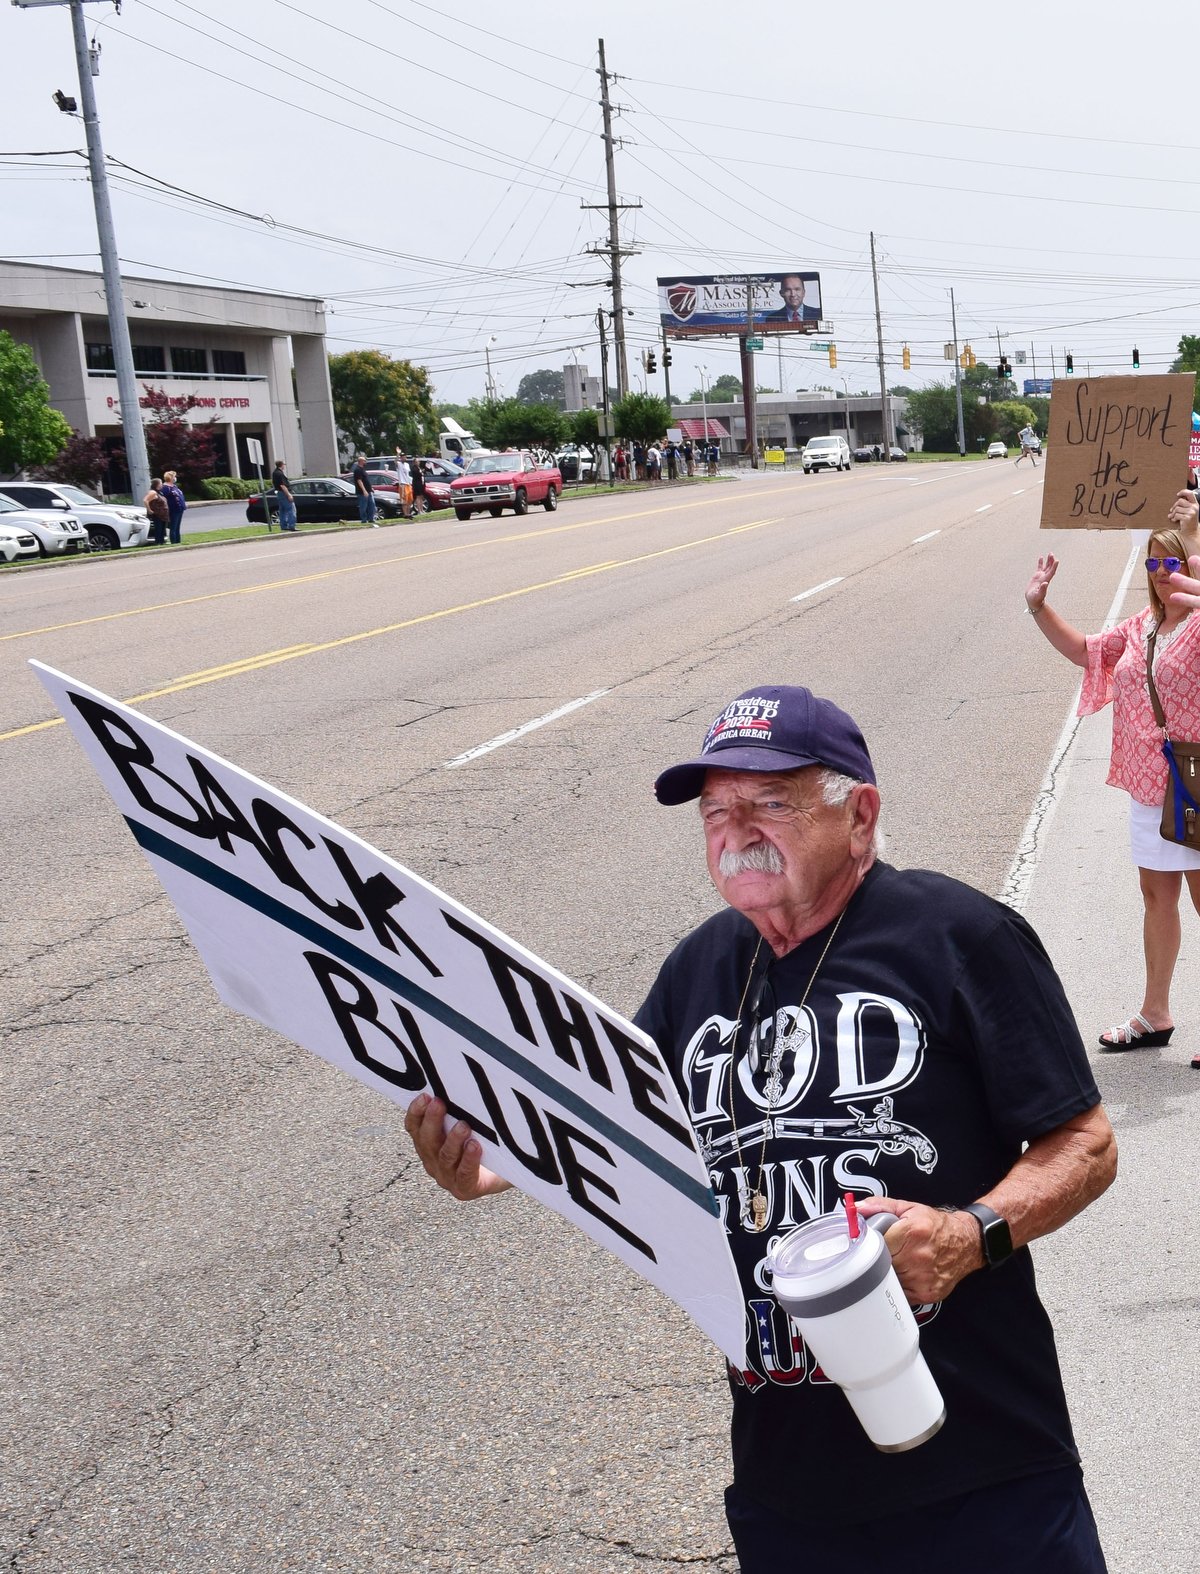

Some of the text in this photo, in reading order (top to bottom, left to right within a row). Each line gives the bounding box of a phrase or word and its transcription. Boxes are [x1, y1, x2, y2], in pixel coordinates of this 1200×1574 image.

[219, 397, 250, 408] CENTER
[1090, 451, 1139, 488] the
[723, 716, 753, 730] 2020
[739, 728, 772, 740] GREAT!
[66, 690, 695, 1151] BACK THE
[681, 991, 927, 1129] GOD
[303, 951, 658, 1264] BLUE
